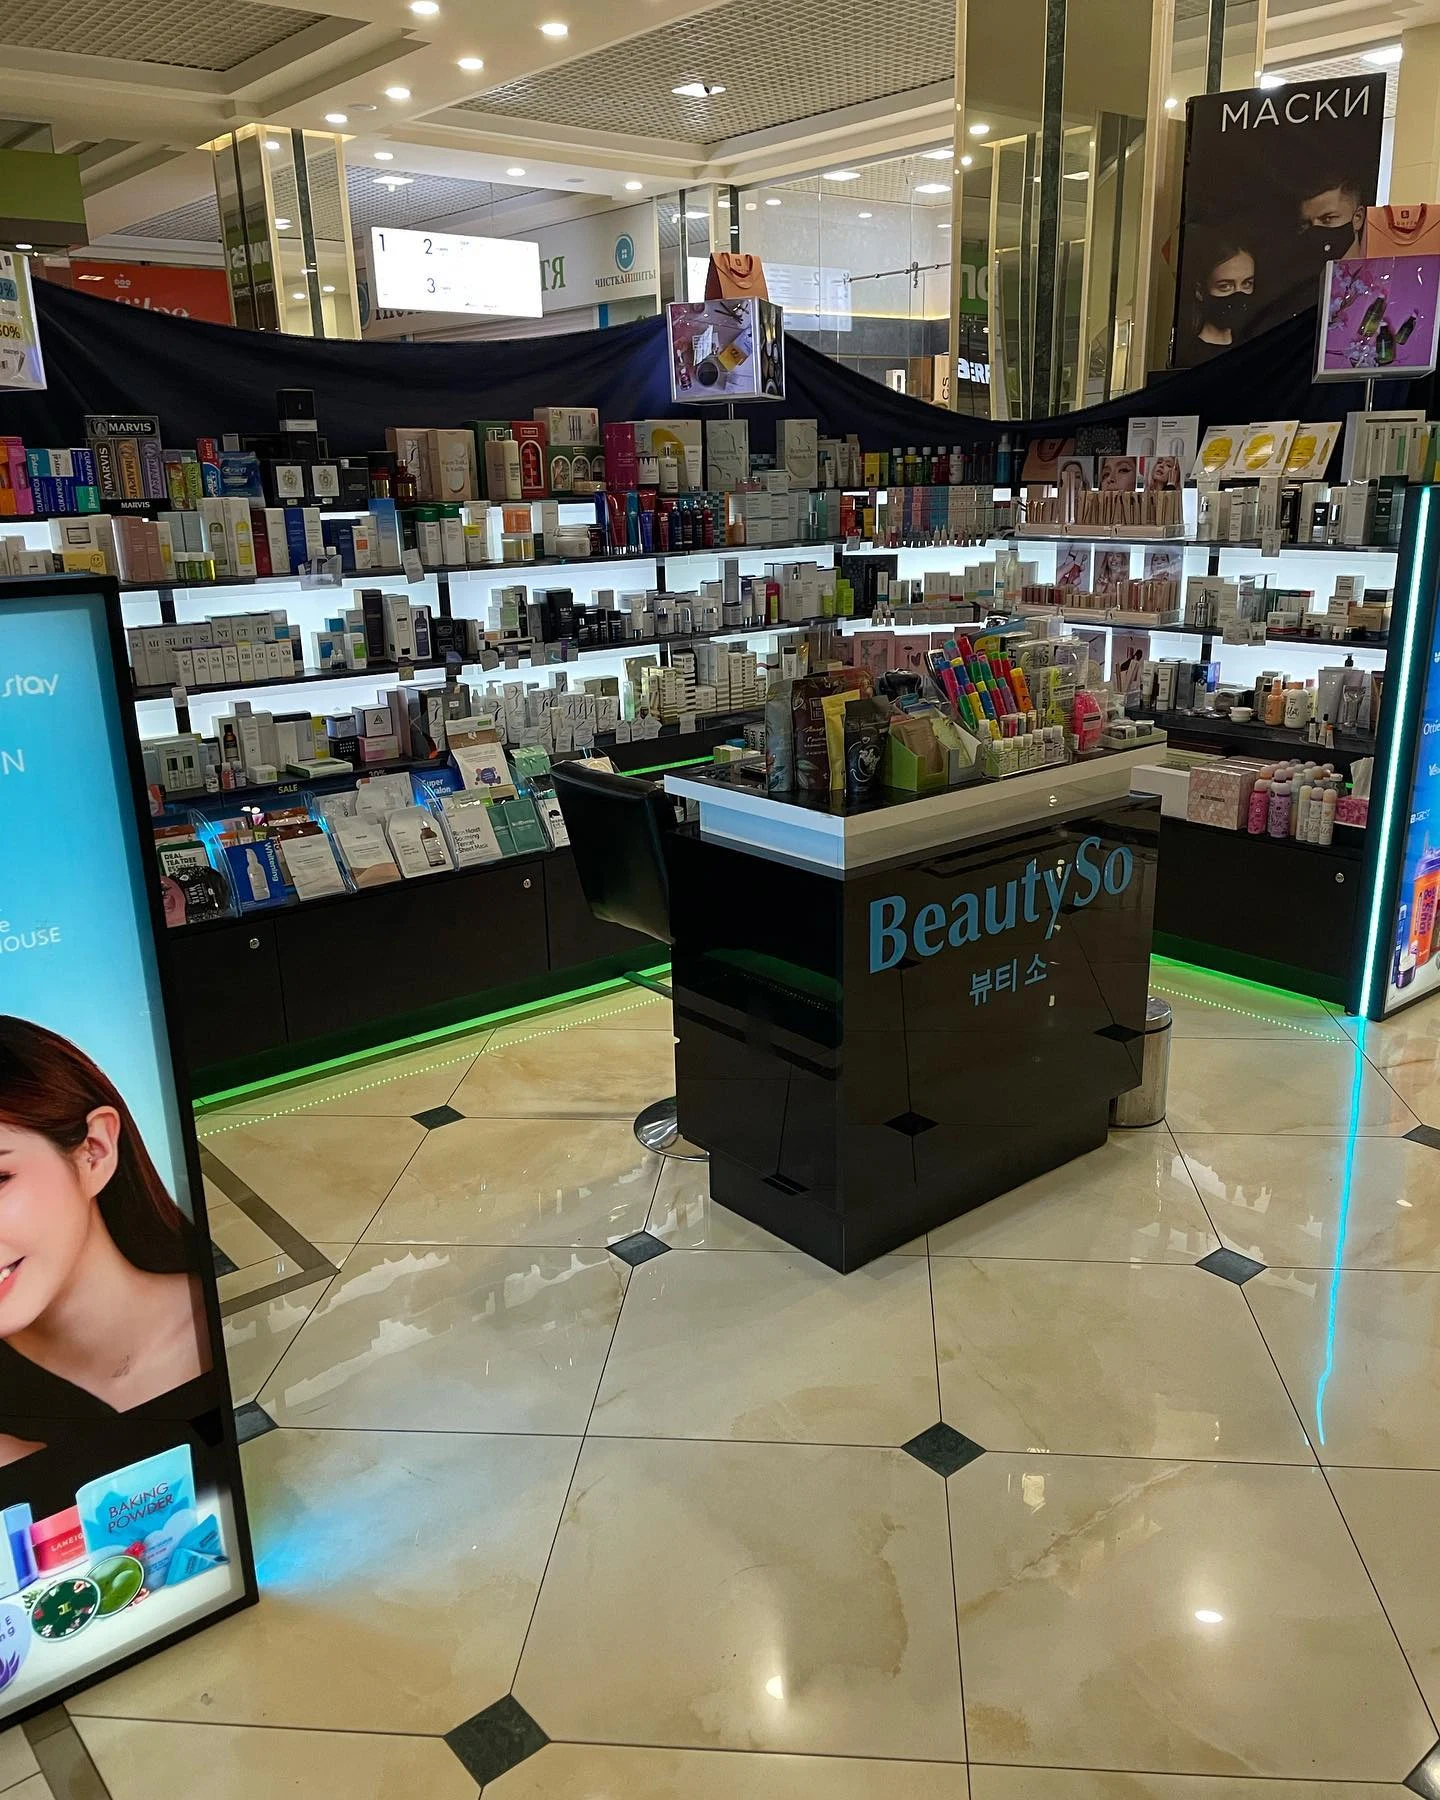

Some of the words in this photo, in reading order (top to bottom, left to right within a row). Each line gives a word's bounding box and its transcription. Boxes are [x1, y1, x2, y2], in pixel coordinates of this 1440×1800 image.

[1221, 85, 1370, 132] МАСКИ
[378, 233, 386, 252] 1
[423, 238, 433, 255] 2
[426, 277, 436, 294] 3
[108, 422, 152, 432] MARVIS
[99, 447, 114, 491] MARVIS
[120, 501, 151, 509] MARVIS
[277, 783, 299, 794] SALE
[263, 841, 280, 883] Whitening
[869, 836, 1135, 975] BeautySo
[107, 1493, 174, 1534] POWDER
[108, 1482, 170, 1518] BAKING
